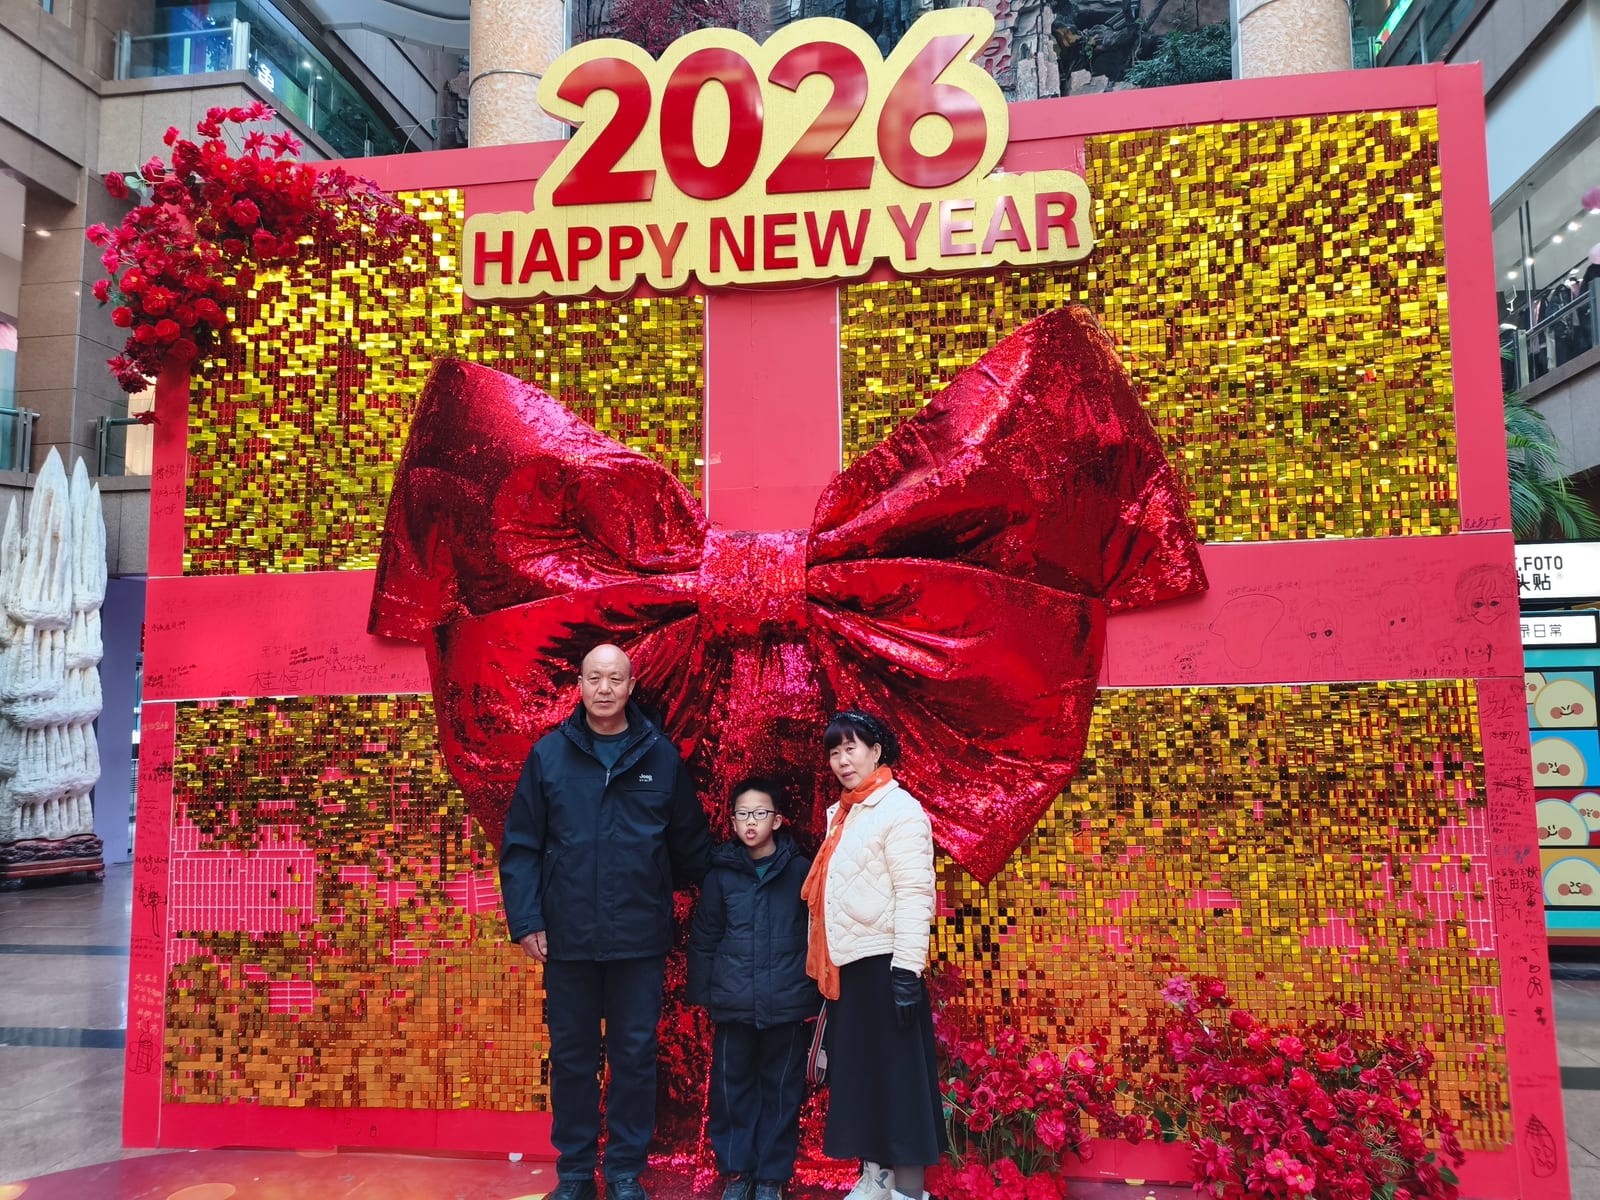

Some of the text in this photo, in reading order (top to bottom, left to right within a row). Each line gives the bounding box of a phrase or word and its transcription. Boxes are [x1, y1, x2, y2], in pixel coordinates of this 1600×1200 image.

[552, 33, 988, 206] 2026
[473, 191, 1080, 286] HAPPY NEW YEAR
[1515, 555, 1563, 571] .FOTO
